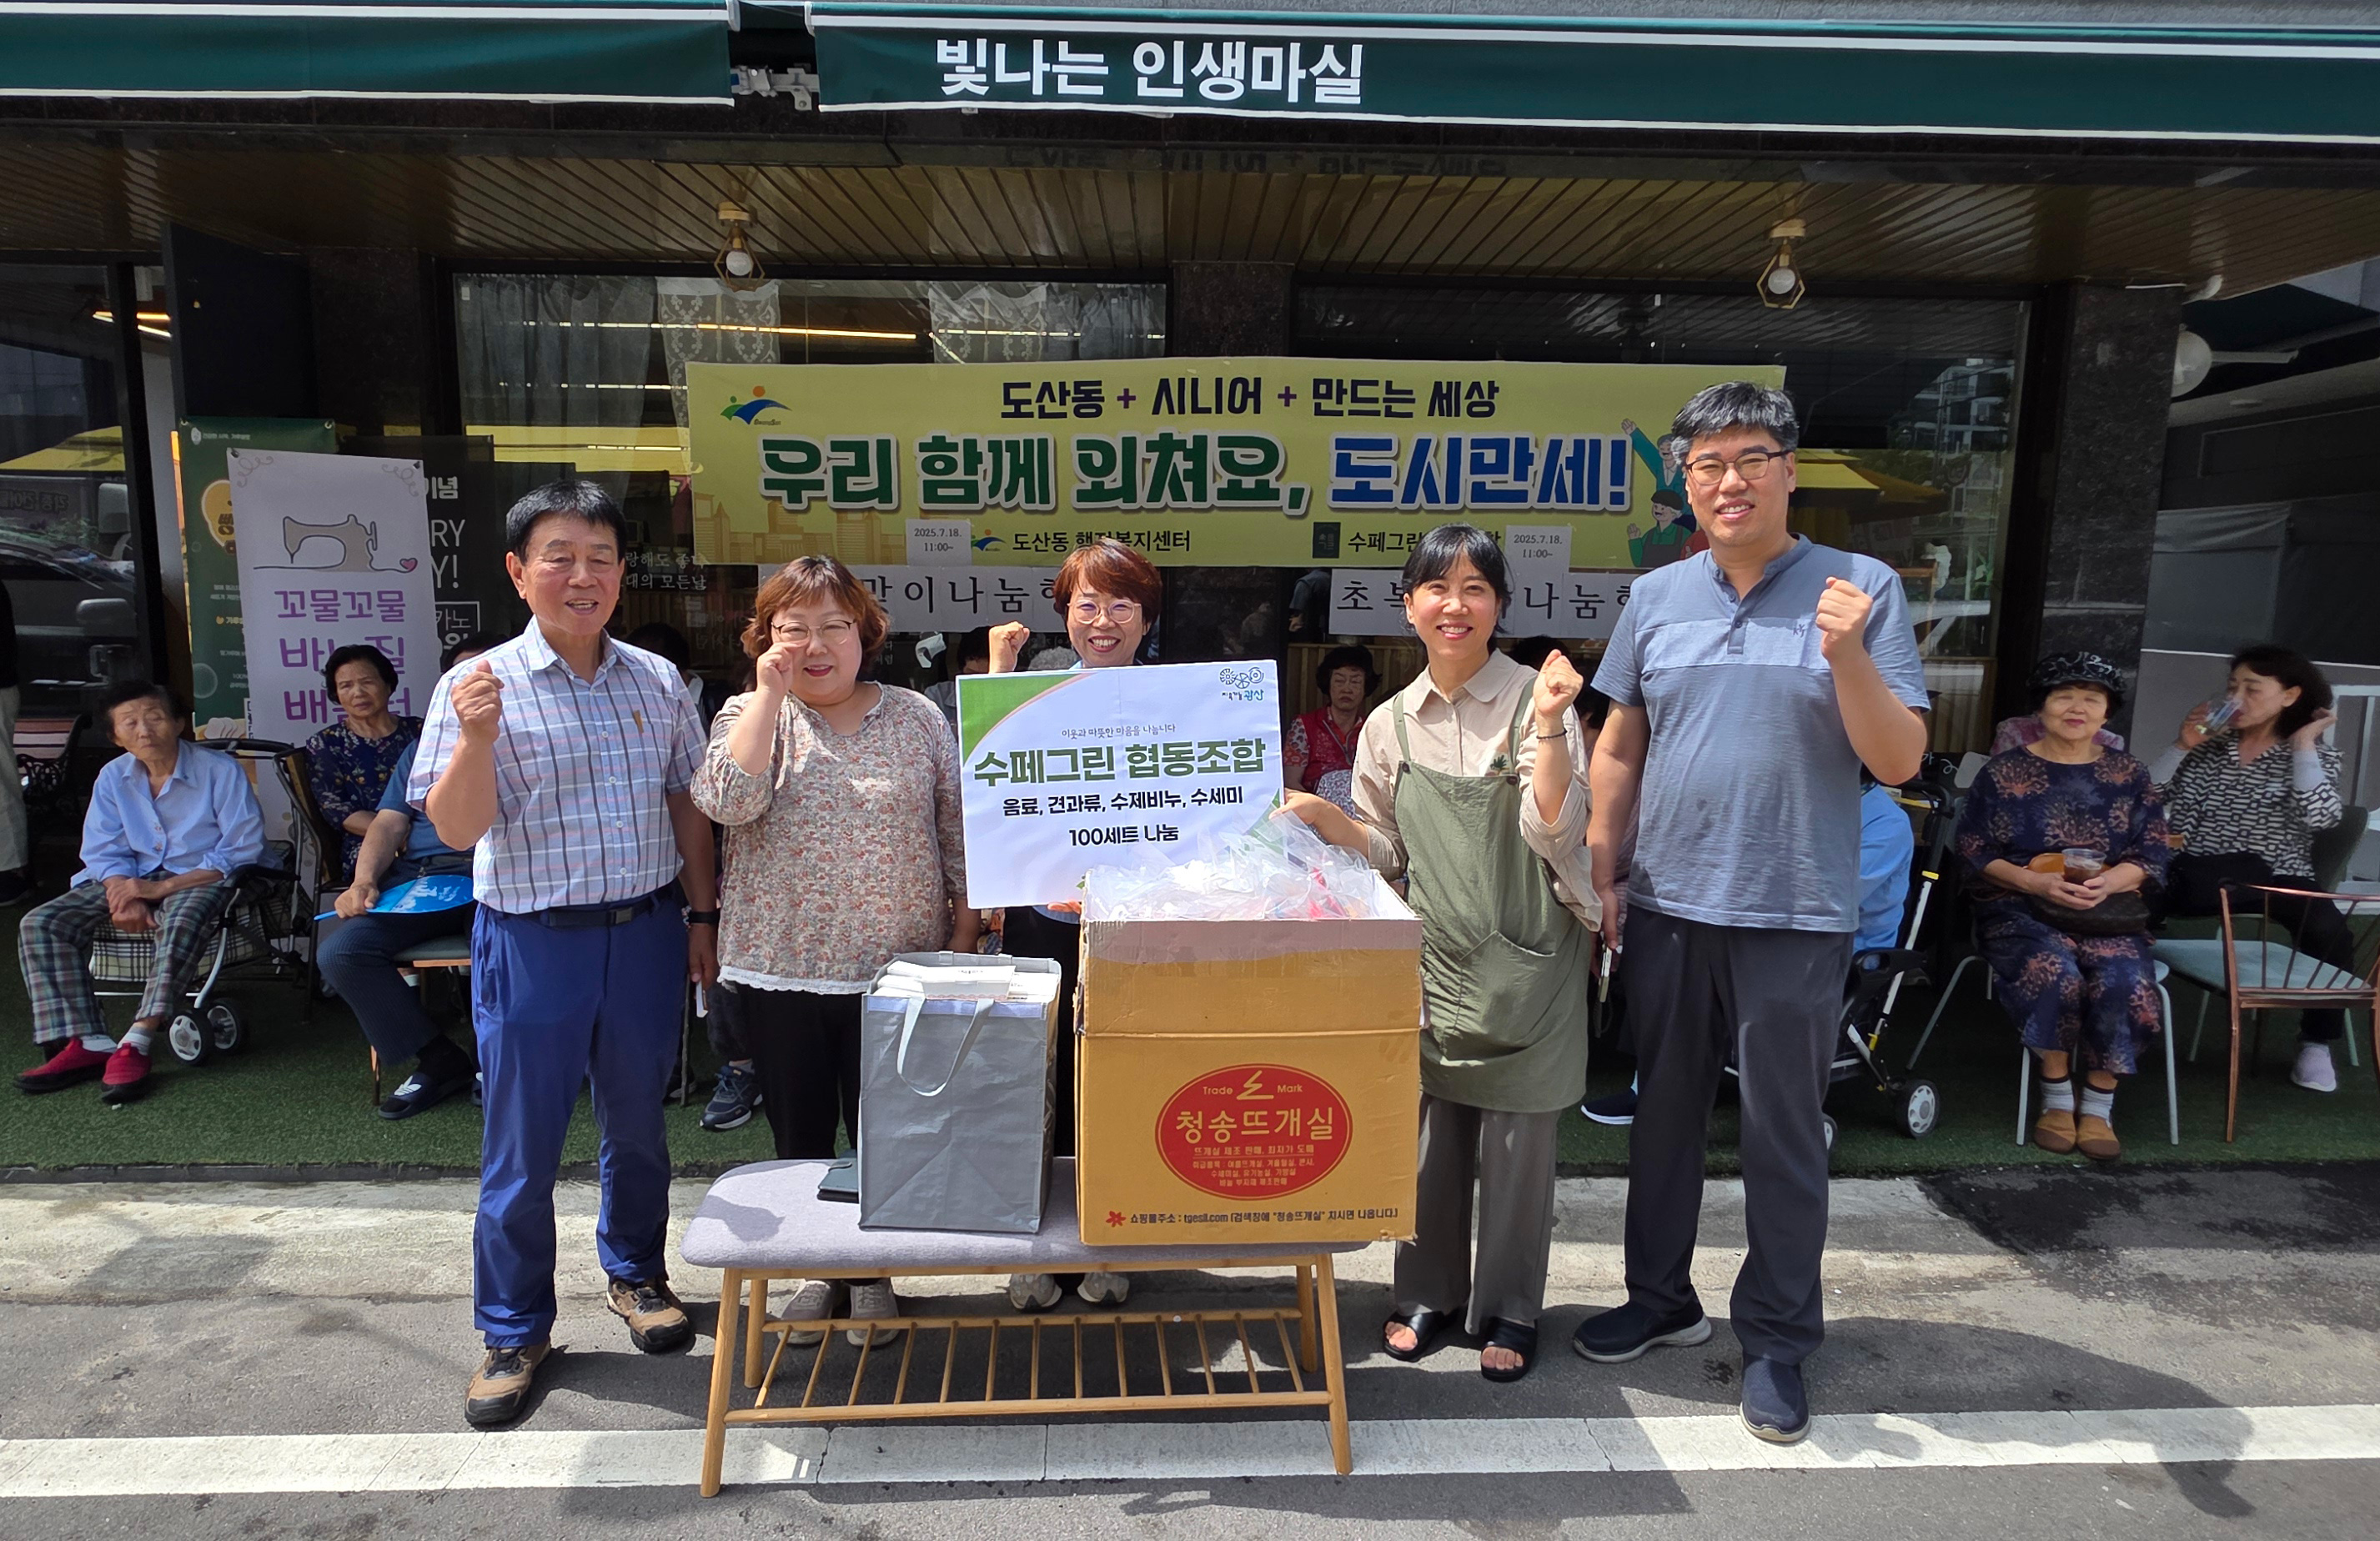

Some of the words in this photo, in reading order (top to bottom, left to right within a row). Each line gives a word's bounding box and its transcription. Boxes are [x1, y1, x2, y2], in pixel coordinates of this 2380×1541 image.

[936, 38, 1109, 98] 빛나는
[1132, 41, 1363, 105] 인생마실
[1001, 379, 1103, 420] 도산동
[1152, 376, 1263, 416] 시니어
[1312, 378, 1416, 419] 만드는
[1427, 379, 1499, 419] 세상
[759, 437, 896, 509] 우리
[918, 433, 1057, 509] 함께
[1073, 432, 1309, 514] 외쳐요,
[1331, 434, 1632, 512] 도시만세!
[914, 528, 962, 539] 2025.7.18.
[1012, 531, 1069, 553] 도산동
[1514, 534, 1563, 545] 2025.7.18.
[924, 542, 954, 553] 11:00~
[1522, 548, 1553, 559] 11:00~
[274, 589, 406, 623] 꼬물꼬물
[279, 636, 406, 672] 바질
[1243, 689, 1264, 701] 광산
[1061, 728, 1087, 740] 이웃과
[1087, 727, 1114, 739] 따뜻한
[1116, 725, 1140, 737] 마음을
[973, 747, 1117, 787] 수페그린
[1126, 737, 1267, 780] 협동조합
[1002, 796, 1044, 816] 음료,
[1047, 794, 1107, 816] 견과류,
[1110, 791, 1187, 811] 수제비누,
[1190, 786, 1243, 806] 수세미
[1068, 825, 1140, 847] 100세트
[1143, 823, 1179, 843] 나눔
[1203, 1086, 1233, 1095] Trade
[1277, 1084, 1303, 1093] Mark
[1175, 1107, 1333, 1143] 청송뜨개실
[1194, 1147, 1220, 1156] 뜨개실
[1130, 1213, 1176, 1224] 쇼핑몰주소
[1328, 1209, 1355, 1221] 치시면
